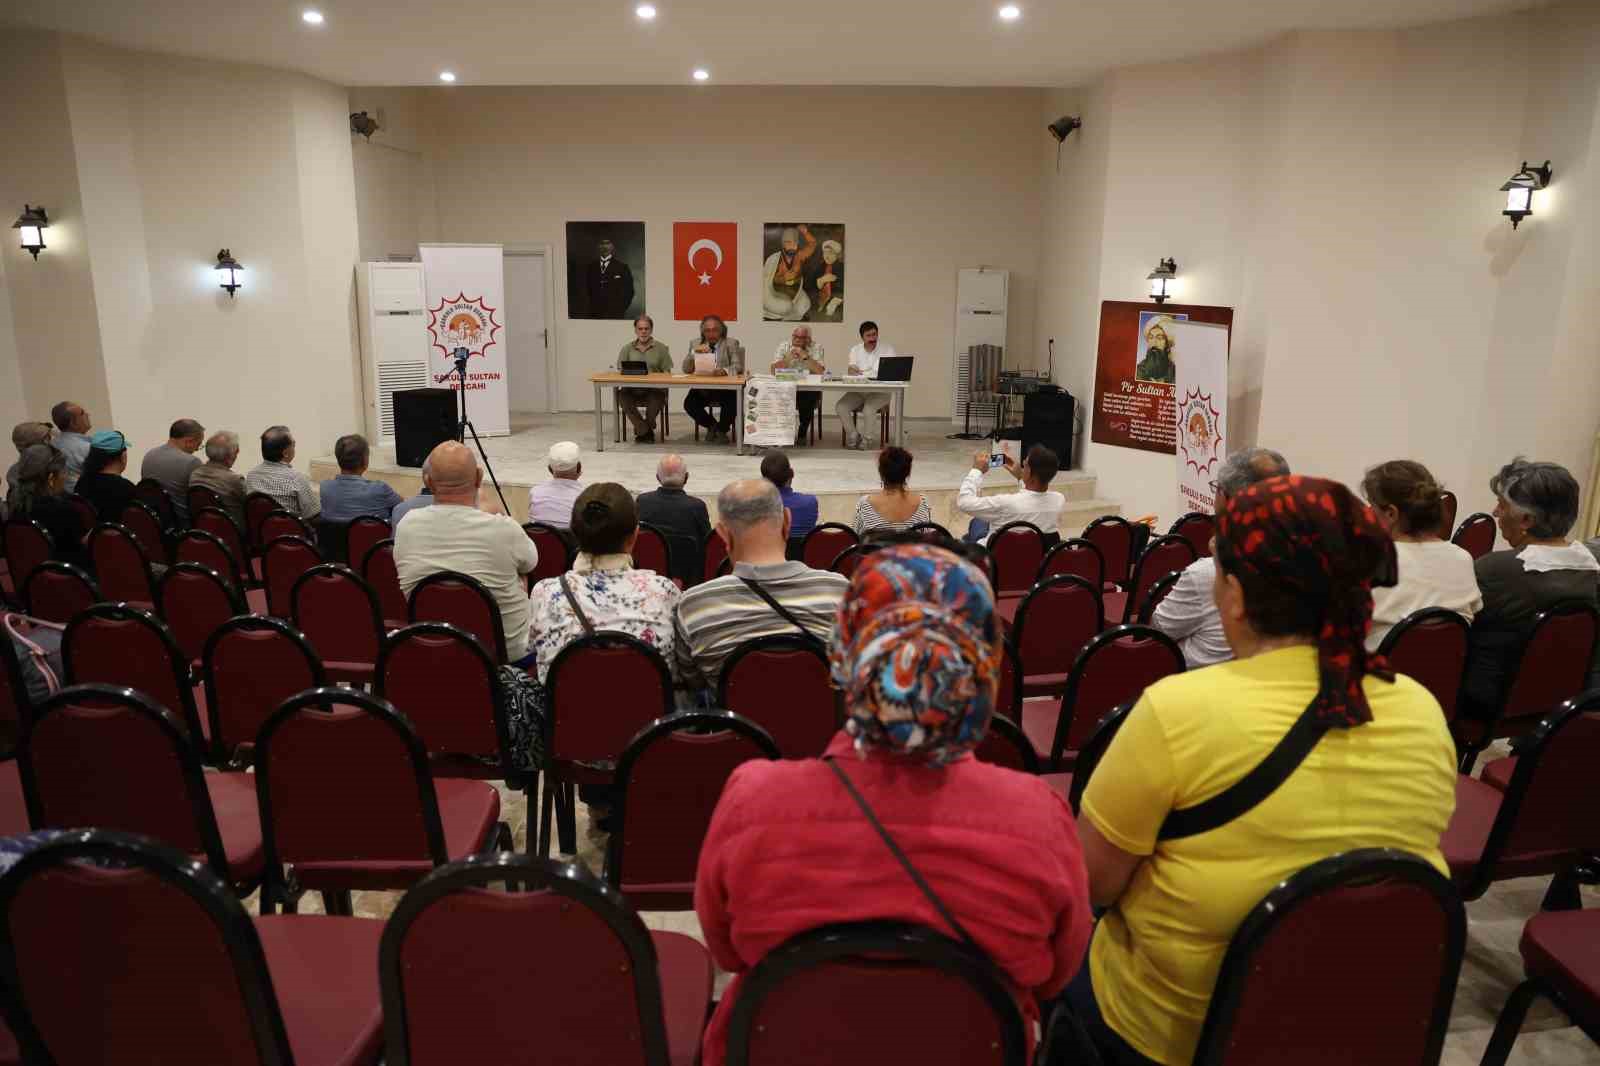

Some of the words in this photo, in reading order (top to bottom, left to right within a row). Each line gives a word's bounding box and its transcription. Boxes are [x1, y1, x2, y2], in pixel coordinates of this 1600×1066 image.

[469, 372, 500, 380] SULTAN
[1121, 381, 1134, 393] Pir
[1136, 383, 1164, 397] Sultan
